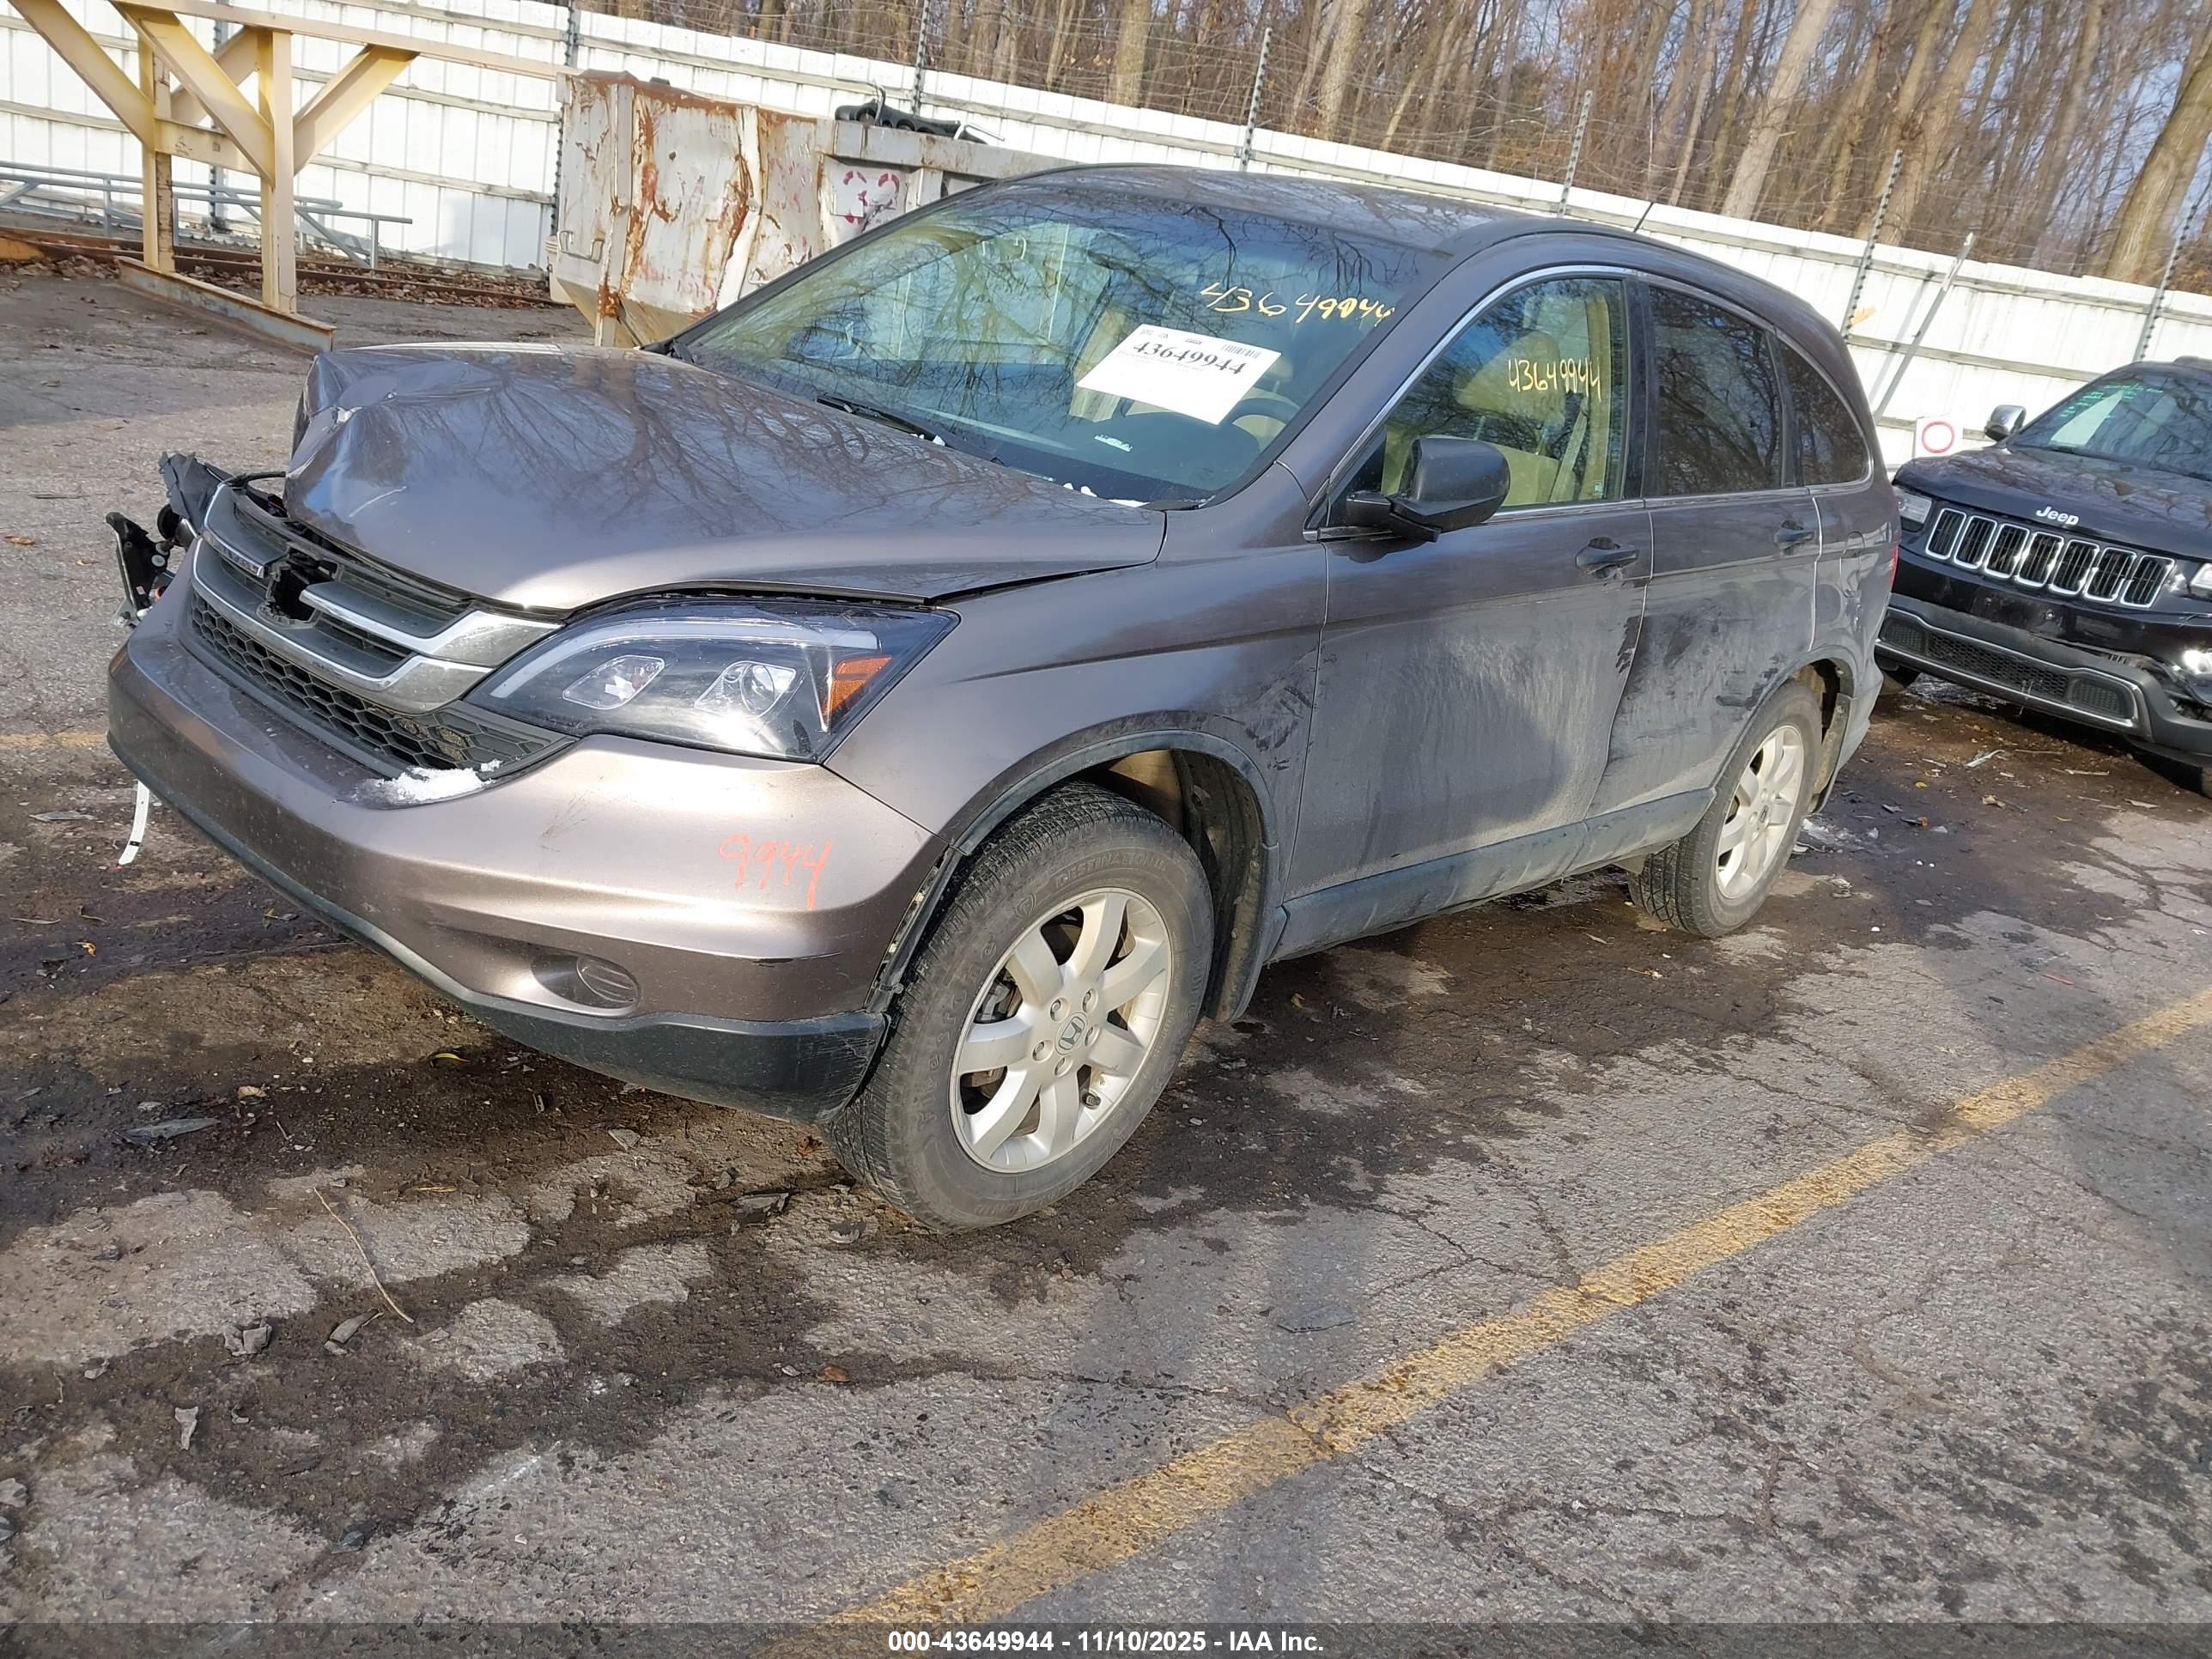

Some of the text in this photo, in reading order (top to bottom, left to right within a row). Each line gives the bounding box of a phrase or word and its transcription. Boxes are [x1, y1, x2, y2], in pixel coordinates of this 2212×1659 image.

[1133, 341, 1247, 374] 43649944
[1508, 356, 1601, 403] 43649944
[2036, 506, 2080, 525] Jeep
[718, 832, 833, 910] 9944
